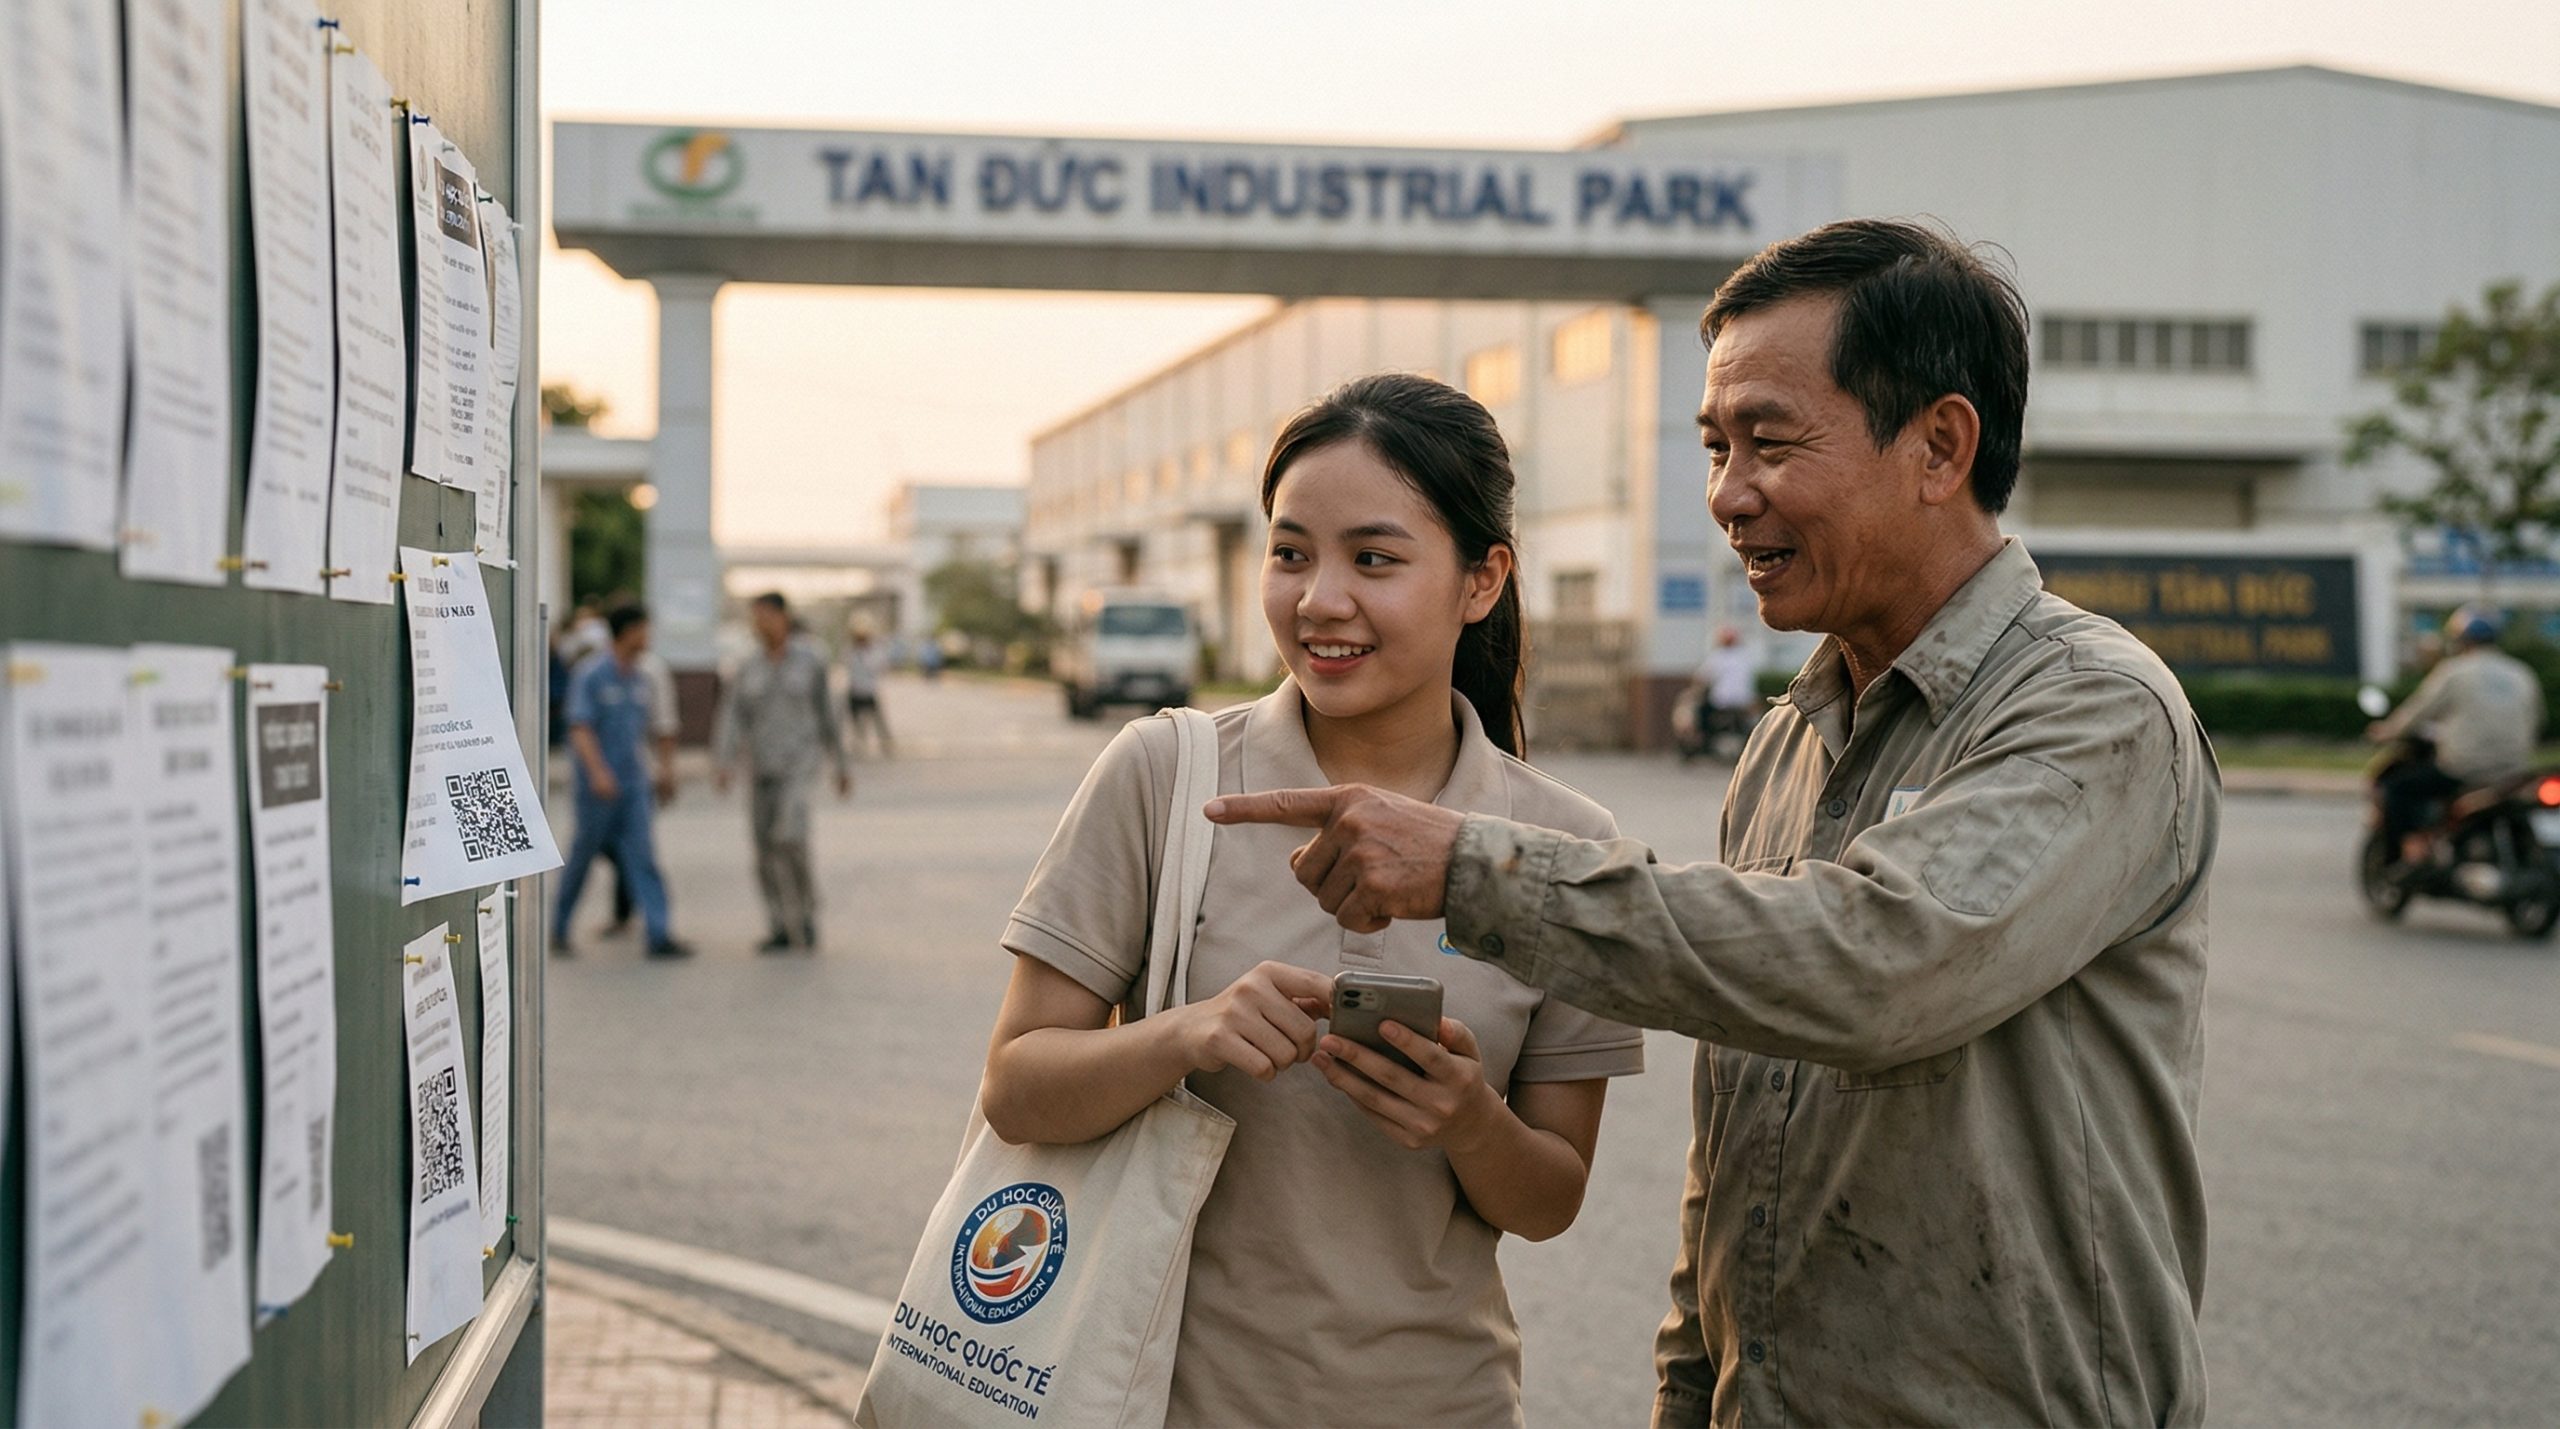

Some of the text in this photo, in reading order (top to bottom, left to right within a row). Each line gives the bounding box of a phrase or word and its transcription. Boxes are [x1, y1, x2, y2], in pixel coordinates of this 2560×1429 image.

[1150, 158, 1551, 226] INDUSTRIAL
[1576, 168, 1755, 229] PARK
[975, 1198, 998, 1221] DU
[988, 1278, 1047, 1319] EDUCATION
[887, 1333, 1039, 1420] NTERNATIONAL EDUCATION
[894, 1301, 1057, 1396] DU HỌC QUỐC TẾ
